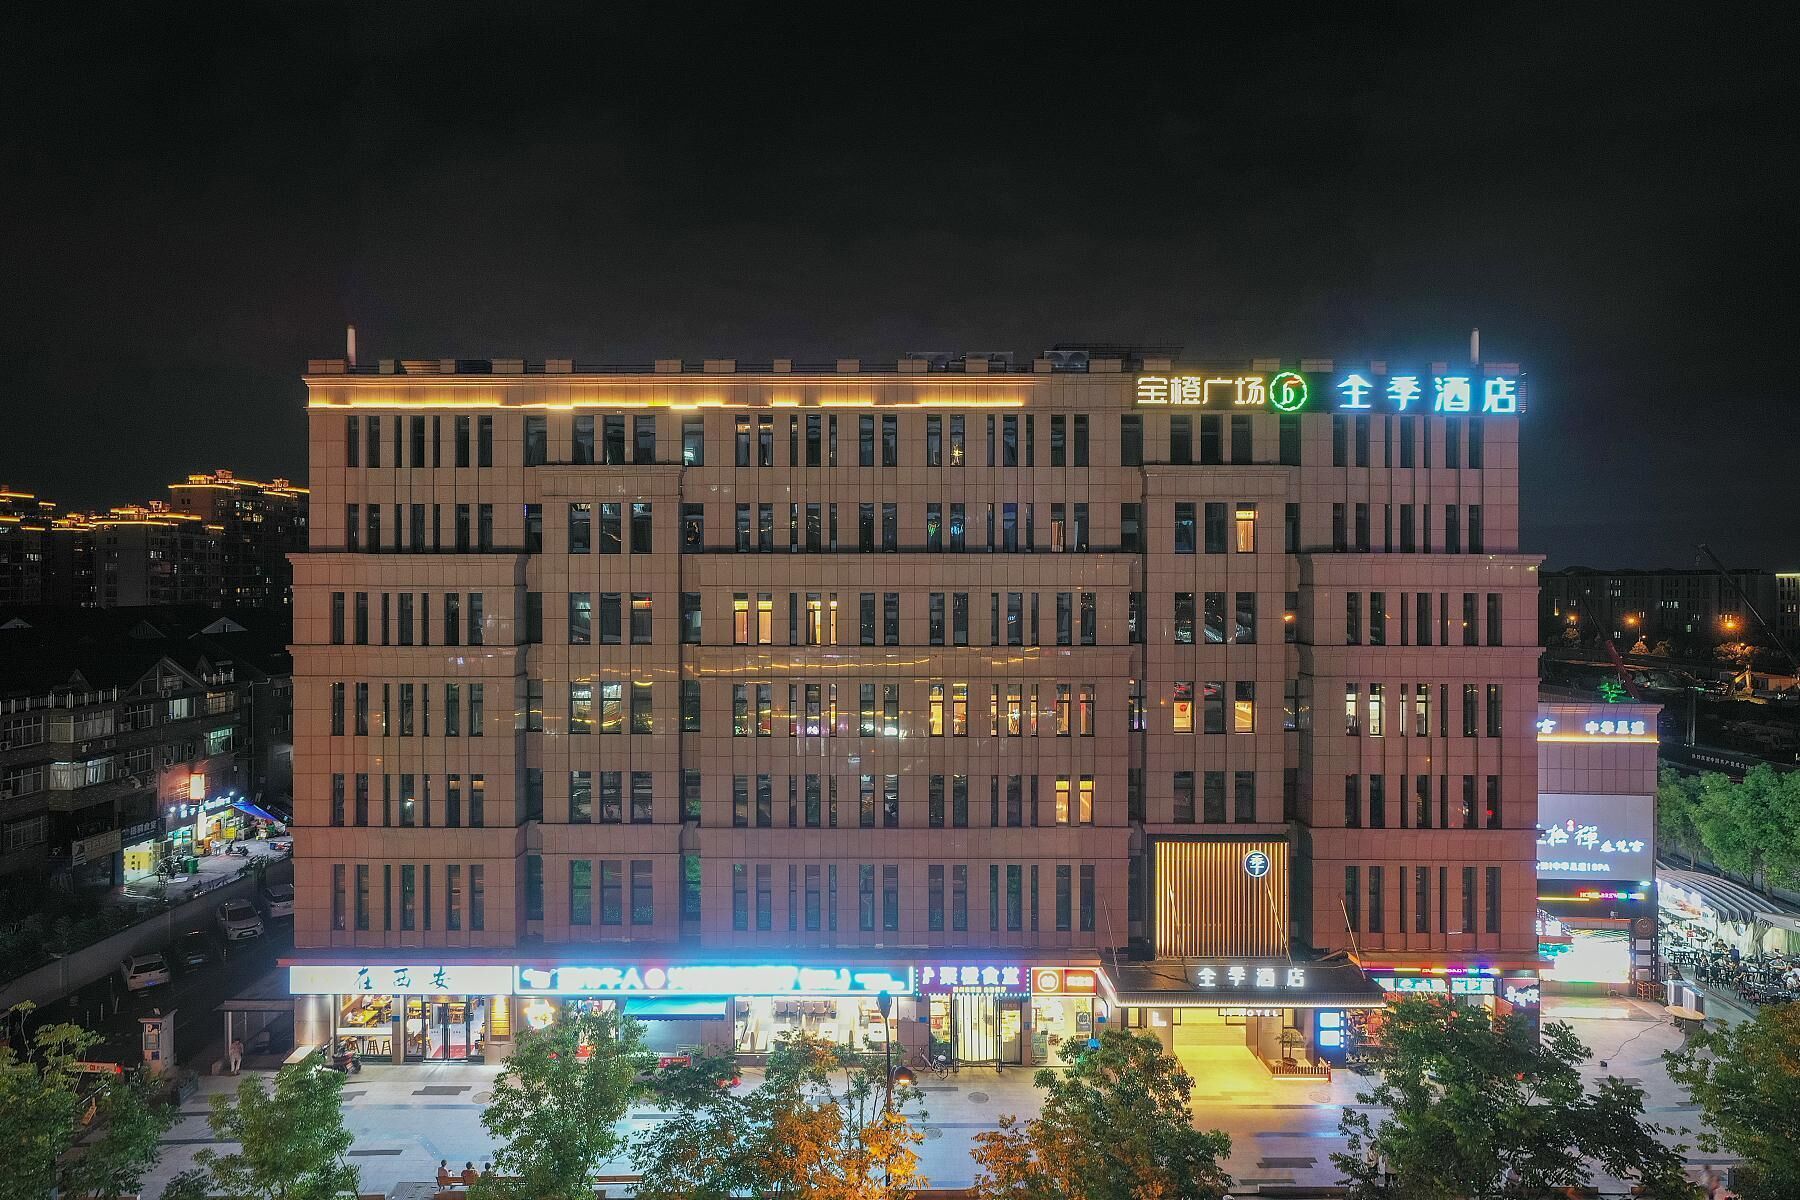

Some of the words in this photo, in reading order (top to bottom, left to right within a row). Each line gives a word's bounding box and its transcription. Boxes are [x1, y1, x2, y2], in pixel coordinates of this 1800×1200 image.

[1137, 376, 1265, 405] 宝橙广场
[1337, 374, 1516, 413] 全季酒店
[1249, 855, 1265, 875] 季
[354, 966, 451, 990] 在西安
[1198, 966, 1305, 988] 全季酒店
